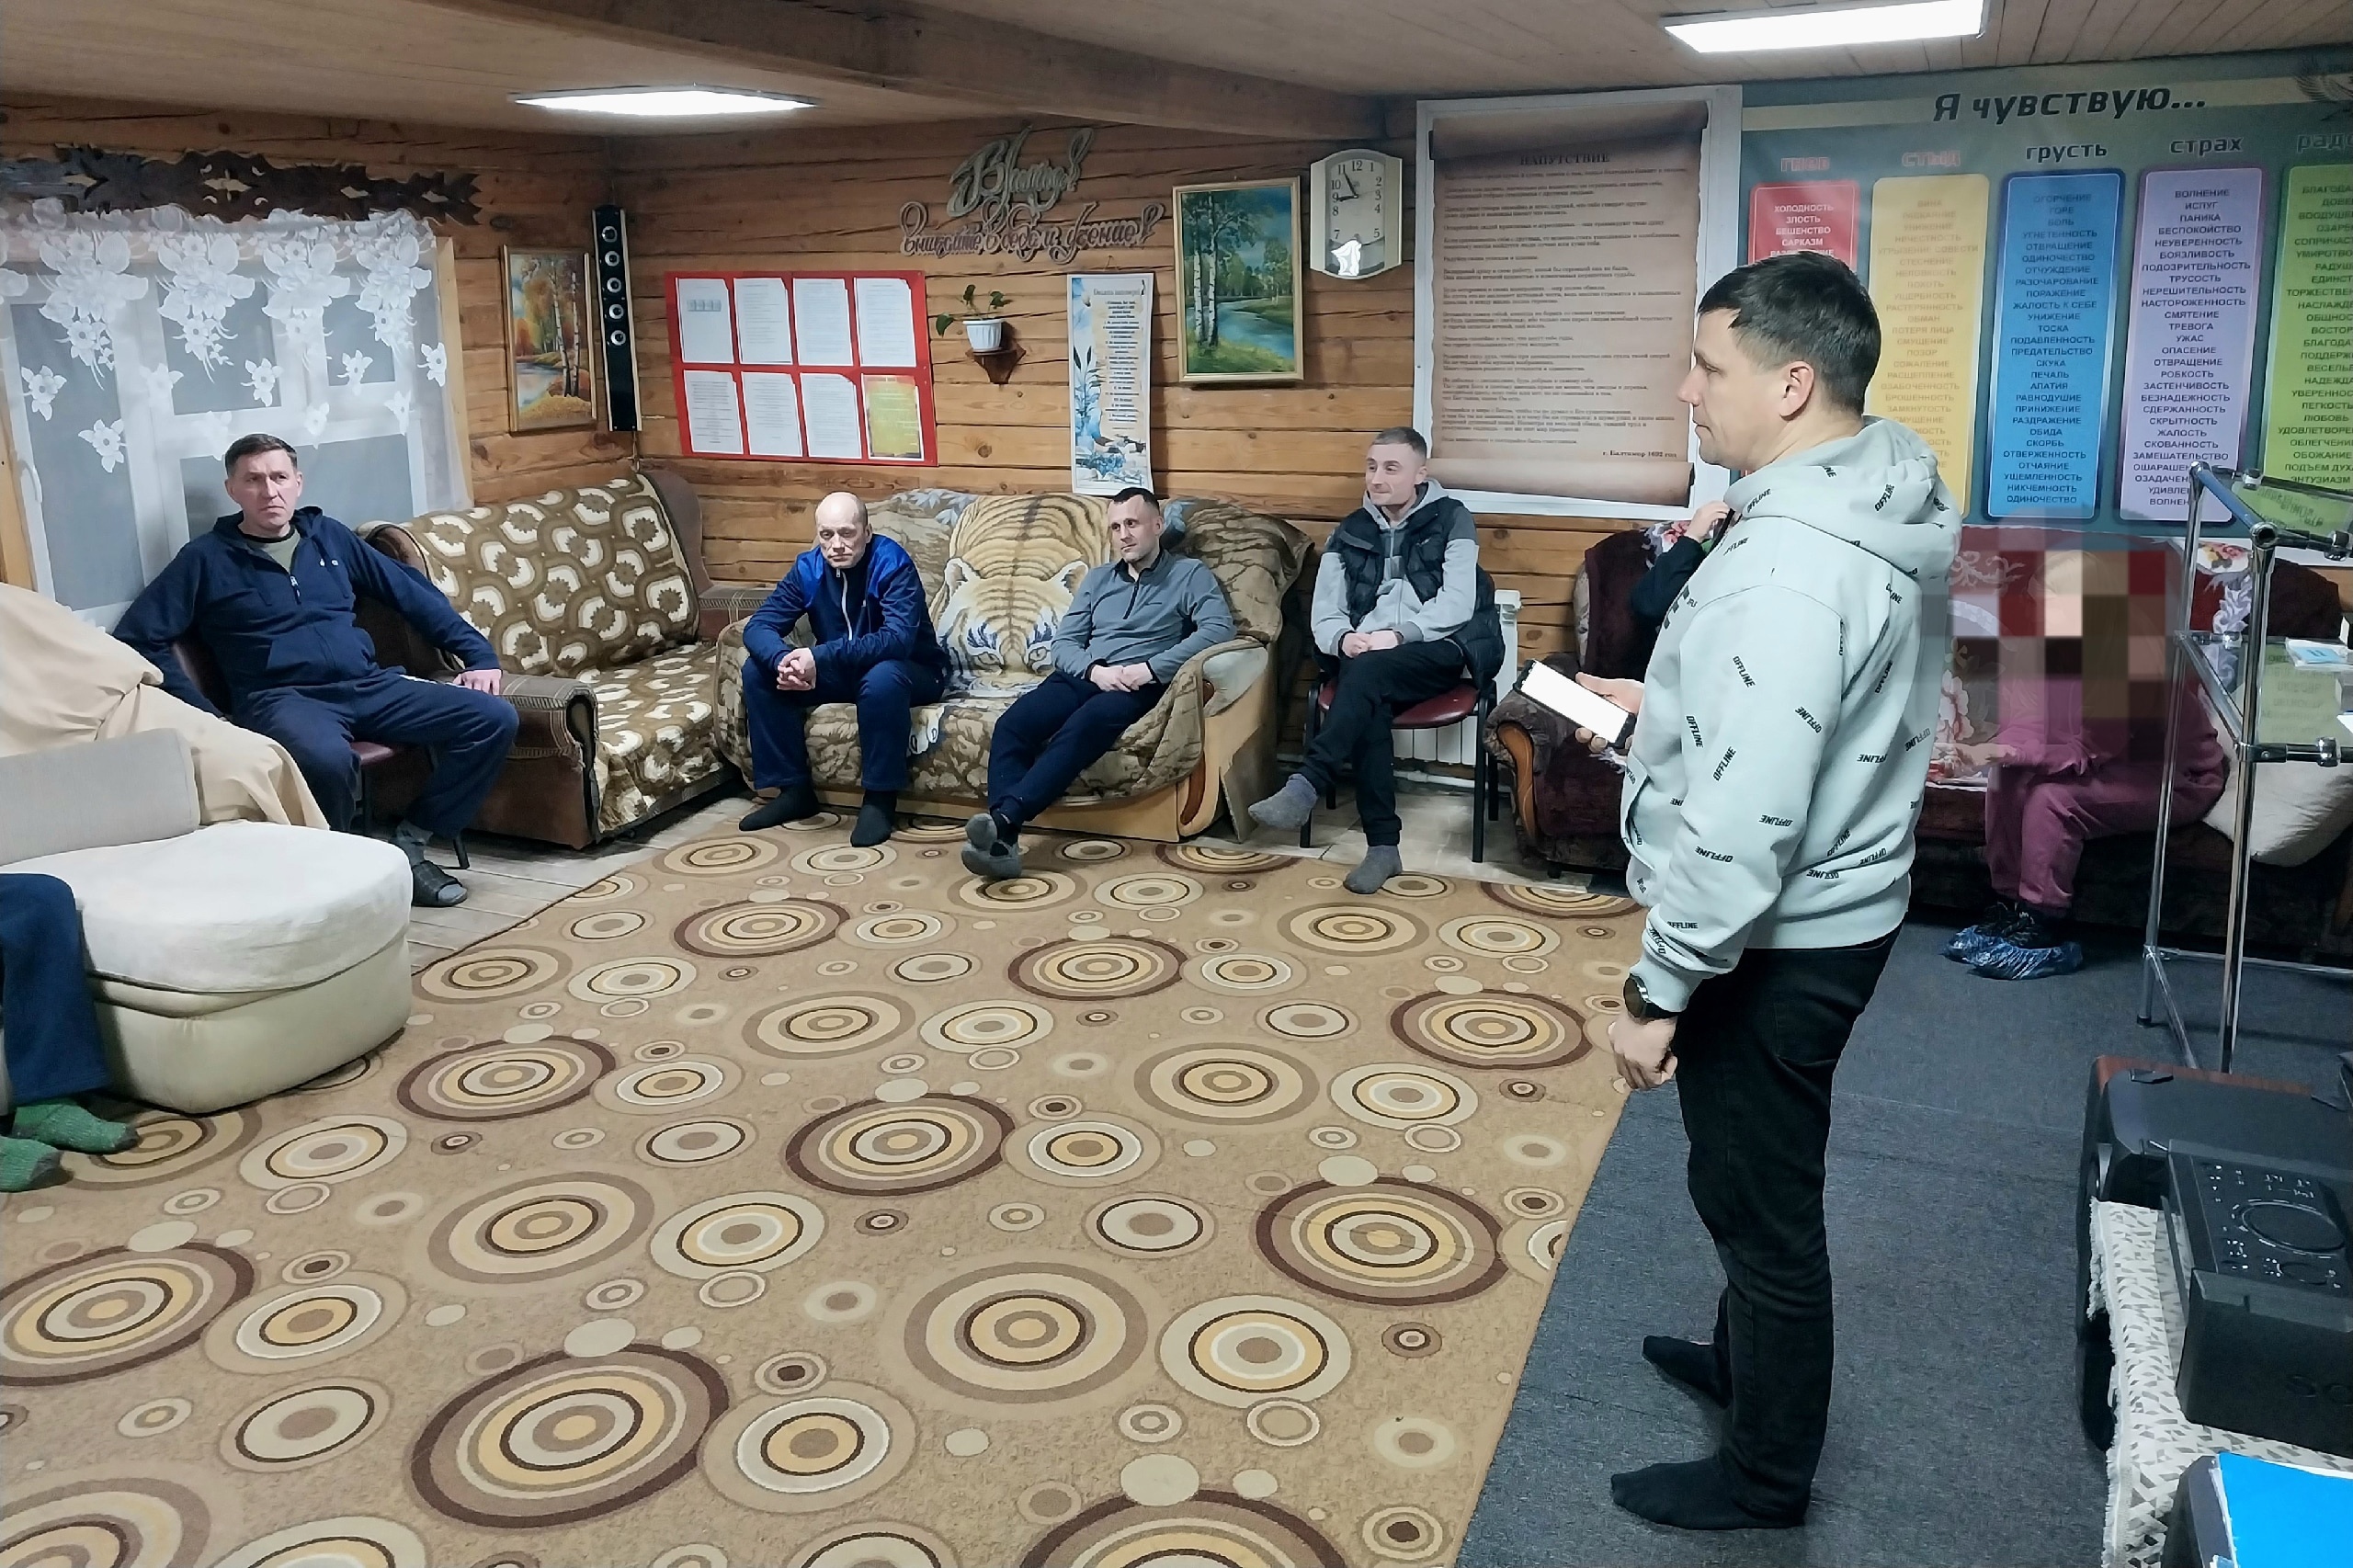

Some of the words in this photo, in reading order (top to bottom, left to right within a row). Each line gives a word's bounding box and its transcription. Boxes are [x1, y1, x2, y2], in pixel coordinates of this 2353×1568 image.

[1933, 93, 1961, 121] Я
[1972, 87, 2206, 125] чувствую...
[2170, 137, 2244, 156] страх
[2025, 142, 2108, 164] грусть
[1520, 153, 1610, 165] НАПУТСТВИЕ
[1901, 151, 1961, 167] стыд
[1352, 160, 1362, 172] 12
[1370, 163, 1374, 172] 1
[1780, 157, 1830, 172] гнев
[1338, 165, 1346, 175] 11
[1332, 179, 1341, 189] 10
[1376, 176, 1381, 186] 2
[2175, 189, 2231, 199] ВОЛНЕНИЕ
[2302, 186, 2353, 194] БЛАГОДА
[1332, 192, 1339, 203] 9
[1375, 190, 1381, 200] 3
[2034, 194, 2092, 203] ОГОРЧЕНИЕ
[2185, 201, 2219, 210] ИСПУГ
[2322, 198, 2353, 206] ДОВЕ
[1332, 206, 1339, 216] 8
[1375, 203, 1381, 213] 4
[2179, 213, 2222, 222] ПАНИКА
[2299, 210, 2353, 220] ВООДУШЕ
[1374, 228, 1380, 238] 5
[1776, 226, 1831, 235] БЕШЕНСТВО
[2158, 225, 2242, 234] БЕСПОКОЙСТВО
[2316, 224, 2353, 233] ОЗАРЕ
[1334, 229, 1340, 239] 7
[1894, 233, 1961, 243] НЕЧЕСТНОСТЬ
[2022, 230, 2097, 239] УГНЕТЕННОСТЬ
[1781, 238, 1824, 246] САРКАЗМ
[2025, 242, 2093, 251] ОТВРАЩЕНИЕ
[2154, 237, 2243, 247] НЕУВЕРЕННОСТЬ
[1935, 244, 1978, 254] СОВЕСТИ
[2296, 249, 2353, 258] УМИРОТВО
[2021, 254, 2096, 263] ОДИНОЧЕСТВО
[2160, 250, 2235, 259] БОЯЗЛИВОСТЬ
[1899, 257, 1953, 266] СТЕСНЕНИЕ
[2024, 266, 2091, 275] ОТЧУЖДЕНИЕ
[2142, 262, 2251, 271] ПОДОЗРИТЕЛЬНОСТЬ
[2314, 263, 2353, 271] РАДУШ
[2015, 278, 2099, 286] РАЗОЧАРОВАНИЕ
[2311, 276, 2353, 284] ЕДИНСТ
[2026, 290, 2086, 298] ПОРАЖЕНИЕ
[2143, 286, 2246, 295] НЕРЕШИТЕЛЬНОСТЬ
[2286, 289, 2353, 297] ТОРЖЕСТВЕН
[2012, 301, 2061, 310] ЖАЛОСТЬ
[2141, 299, 2246, 307] НАСТОРОЖЕННОСТЬ
[2298, 301, 2353, 311] НАСЛАЖДЕ
[2027, 312, 2081, 321] УНИЖЕНИЕ
[2164, 311, 2220, 319] СМЯТЕНИЕ
[1930, 326, 1954, 335] ЛИЦА
[2010, 336, 2096, 345] ПОДАВЛЕННОСТЬ
[2303, 339, 2353, 347] БЛАГОДА
[2301, 352, 2353, 360] ПОДДЕРЖ
[1881, 382, 1960, 391] ОЗАБОЧЕННОСТЬ
[2143, 381, 2230, 390] ЗАСТЕНЧИВОСТЬ
[2291, 389, 2353, 398] УВЕРЕННОС
[2141, 394, 2231, 403] БЕЗНАДЕЖНОСТЬ
[2149, 417, 2218, 426] СКРЫТНОСТЬ
[2278, 427, 2353, 436] УДОВЛЕТВОРЕ
[2143, 440, 2219, 449] СКОВАННОСТЬ
[2003, 450, 2086, 459] ОТВЕРЖЕННОСТЬ
[2132, 452, 2229, 460] ЗАМЕШАТЕЛЬСТВО
[2293, 451, 2351, 460] ОБОЖАНИЕ
[2133, 463, 2189, 472] ОШАРАШЕН
[2285, 463, 2330, 472] ПОДЪЕМ
[2004, 473, 2083, 482] УЩЕМЛЕННОСТЬ
[2006, 484, 2077, 493] НИКЧЕМНОСТЬ
[1747, 488, 1771, 513] OFFLINE
[1875, 483, 1894, 511] OFFLINE
[2006, 495, 2077, 504] ОДИНОЧЕСТВО
[1733, 656, 1756, 687] OFFLINE
[1795, 706, 1823, 733] OFFLINE
[1686, 715, 1703, 748] OFFLINE
[1904, 728, 1931, 752] OFFLINE
[1712, 746, 1736, 781] OFFLINE
[1758, 814, 1793, 827] OFFLINE
[1826, 827, 1850, 857] OFFLINE
[1695, 846, 1733, 863] OFFLINE
[1859, 847, 1887, 865] OFFLINE
